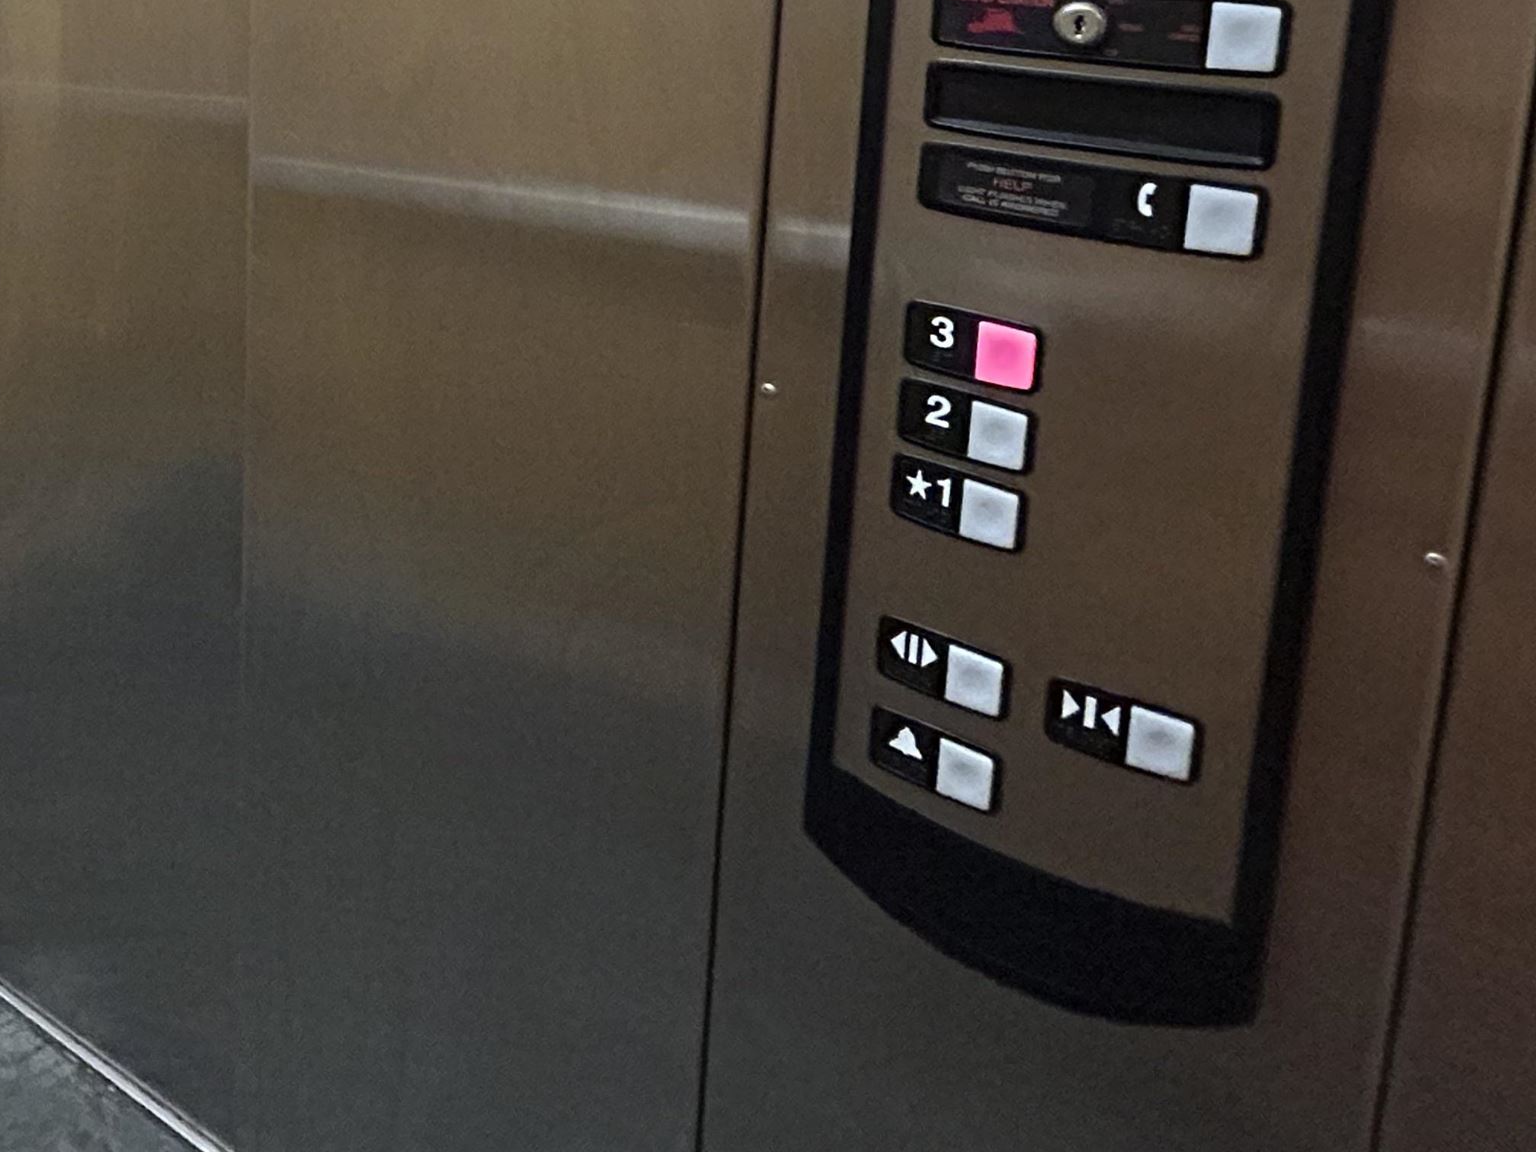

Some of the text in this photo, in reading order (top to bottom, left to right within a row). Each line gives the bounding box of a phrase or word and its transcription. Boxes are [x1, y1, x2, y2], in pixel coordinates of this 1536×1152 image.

[992, 176, 1033, 193] HELP
[929, 315, 955, 349] 3
[925, 395, 952, 428] 2
